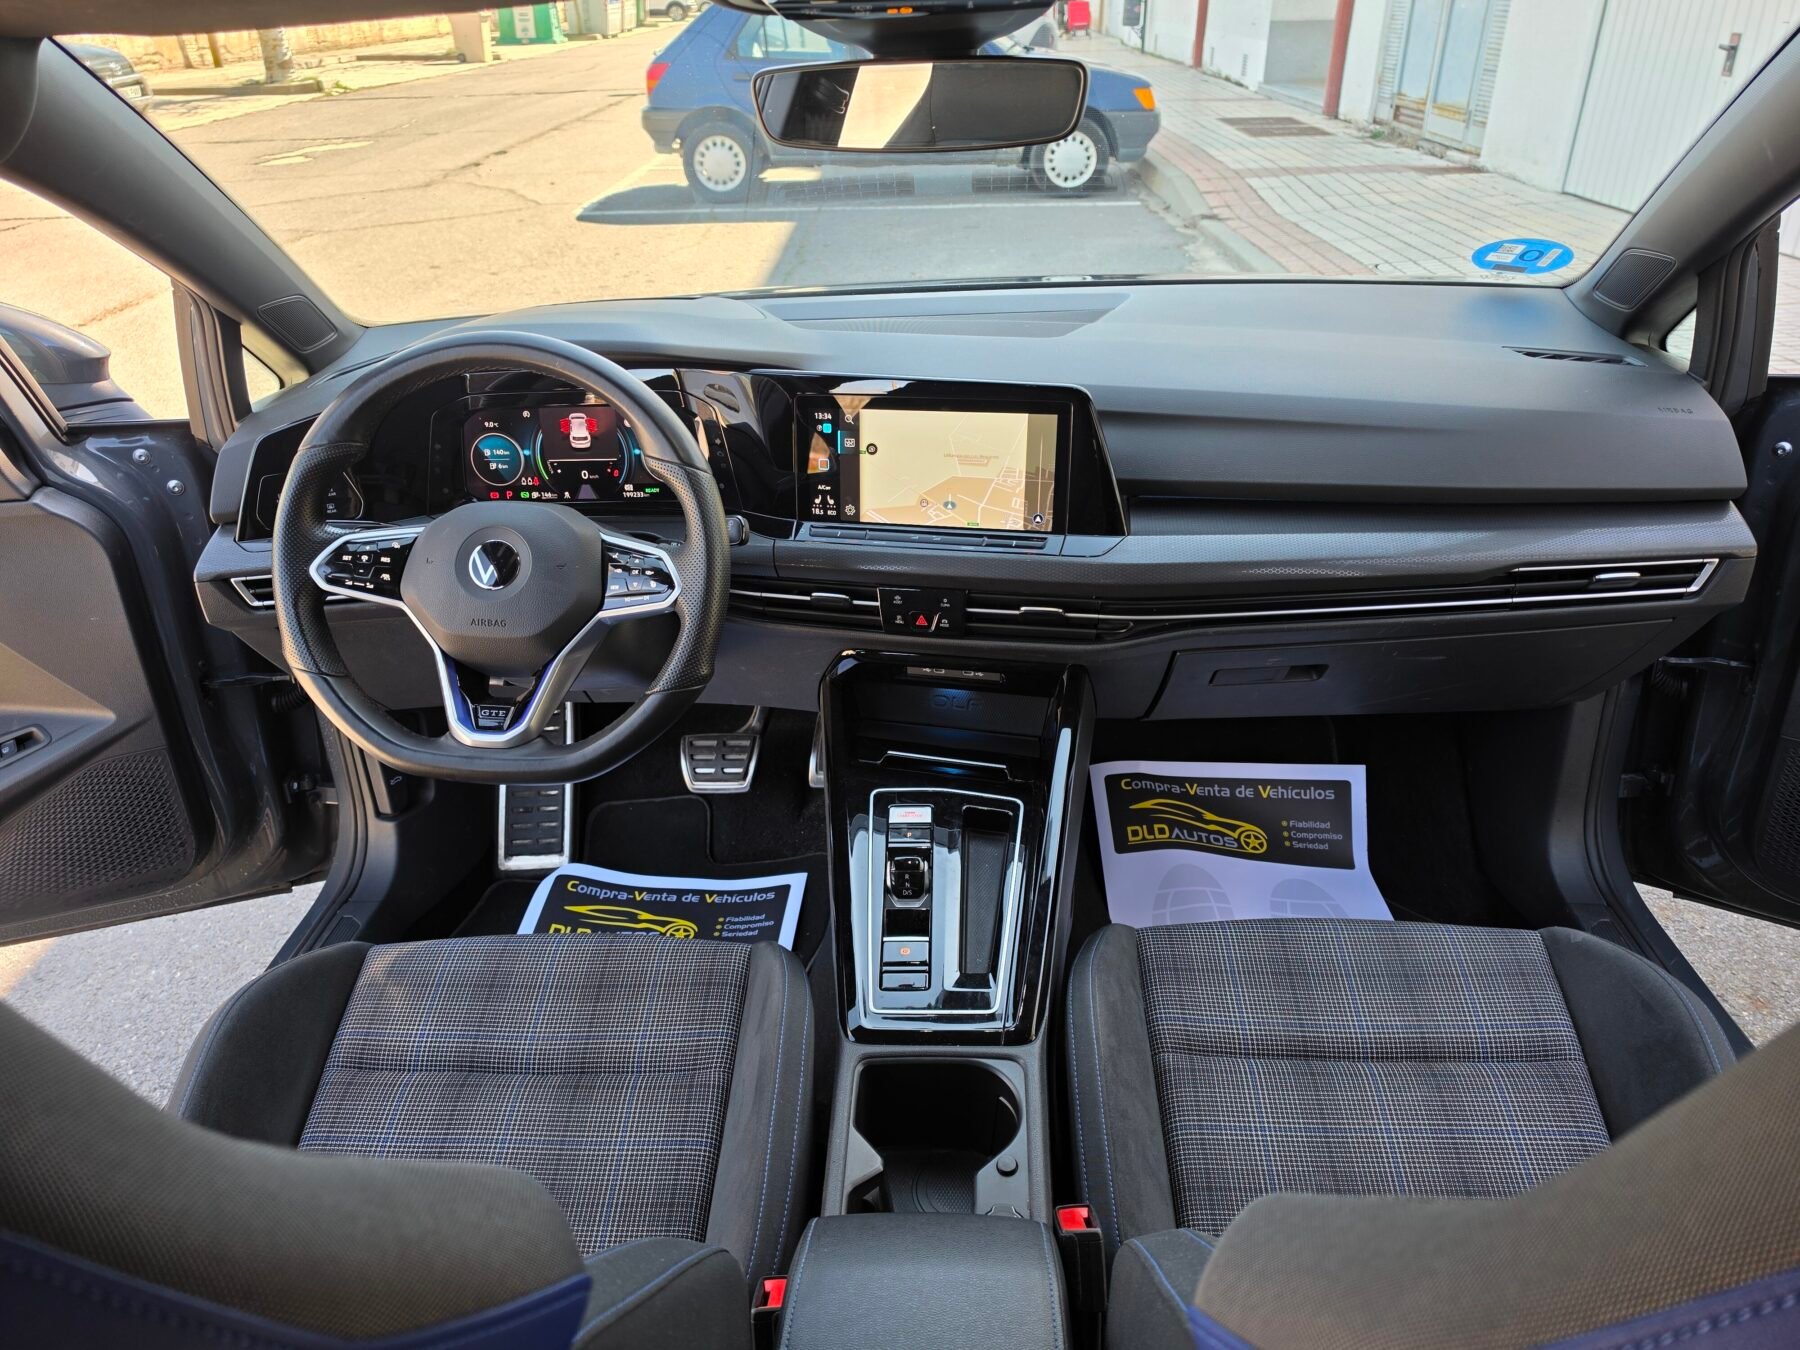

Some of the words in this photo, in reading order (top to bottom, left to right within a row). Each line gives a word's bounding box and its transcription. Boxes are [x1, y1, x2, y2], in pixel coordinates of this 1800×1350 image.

[470, 618, 507, 627] AIRBAG
[481, 709, 506, 717] GTE
[1120, 778, 1230, 798] Compra-Venta
[1236, 785, 1255, 798] de
[1258, 784, 1336, 800] Vehículos
[1289, 820, 1331, 829] Fiabilidad
[1290, 830, 1343, 841] Compromiso
[1292, 841, 1329, 850] Seriedad
[566, 880, 678, 903] Compra-Venta
[681, 892, 700, 903] de
[705, 891, 776, 904] Vehículos
[725, 913, 766, 923] Fiabilidad
[723, 920, 775, 931] Compromiso
[721, 929, 759, 938] Seriedad
